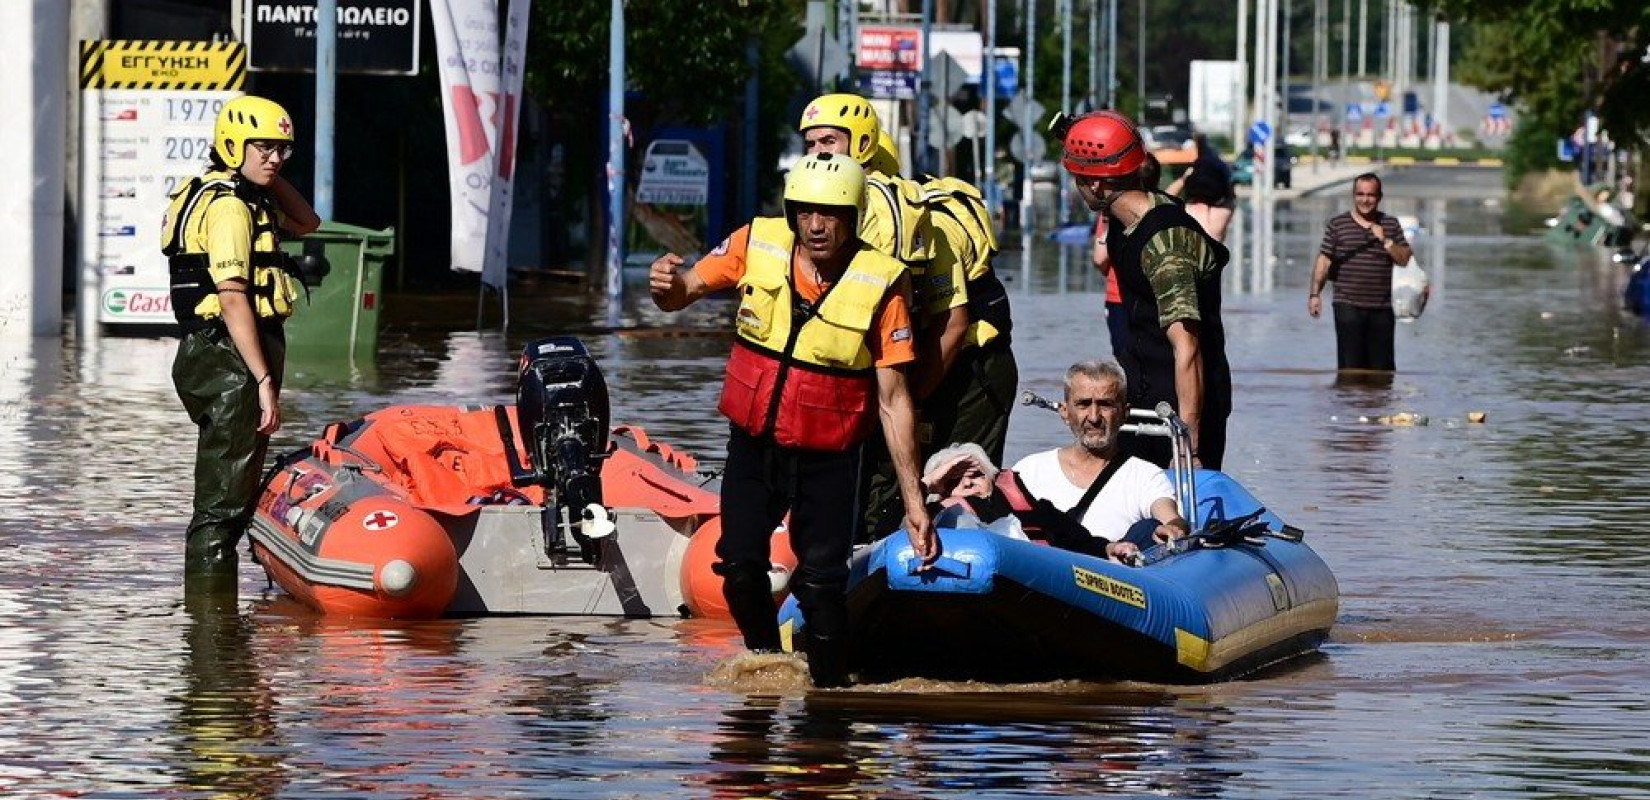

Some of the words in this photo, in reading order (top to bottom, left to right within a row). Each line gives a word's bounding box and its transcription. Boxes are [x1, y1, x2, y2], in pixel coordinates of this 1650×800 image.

[257, 4, 410, 26] ΠΑΝΤΩΛΕΙΟ
[121, 55, 209, 69] ΕΓΓΥΗΣΗ
[166, 136, 208, 160] 202
[129, 293, 175, 313] Cast
